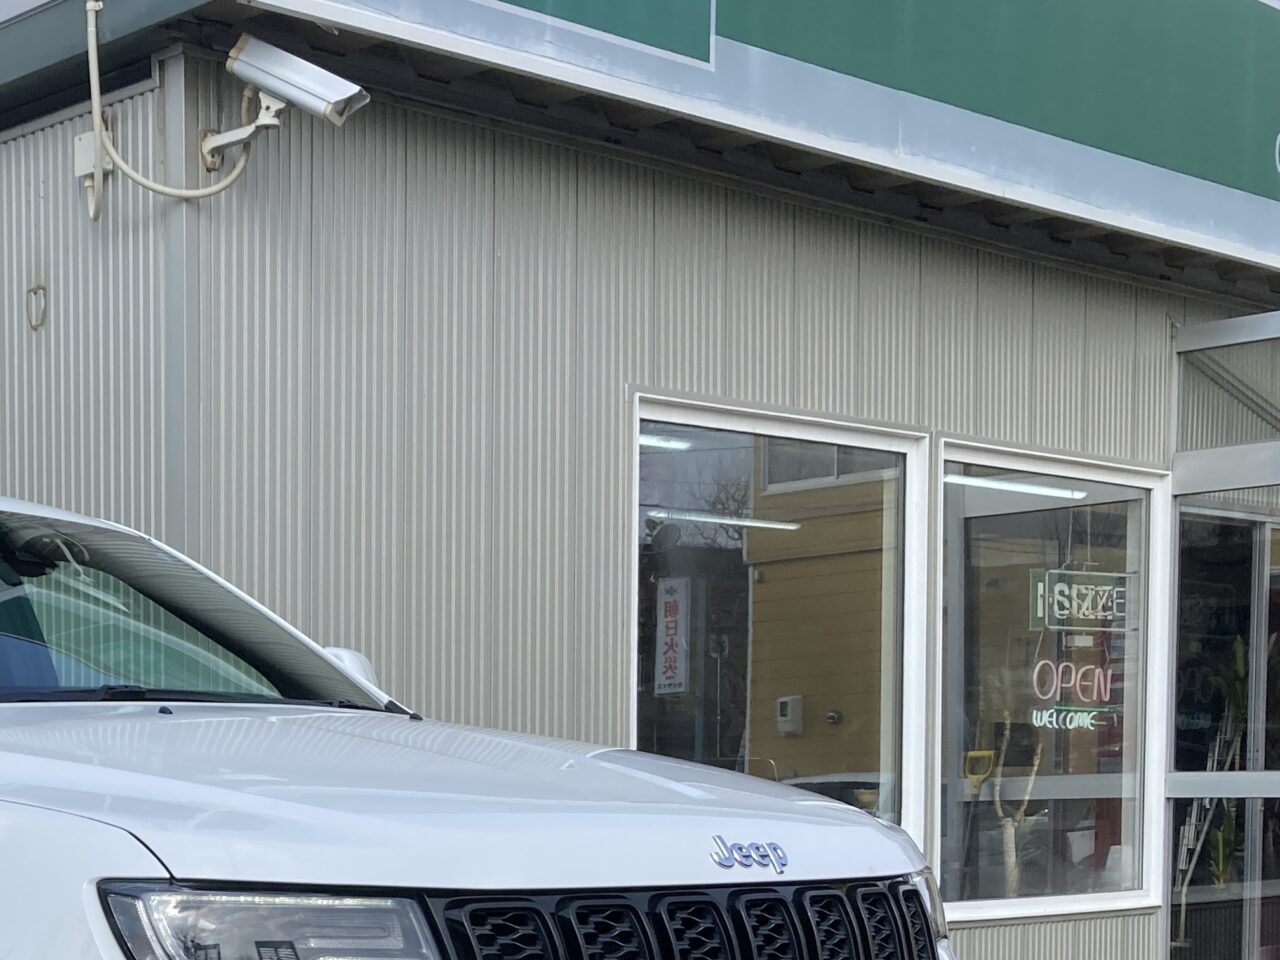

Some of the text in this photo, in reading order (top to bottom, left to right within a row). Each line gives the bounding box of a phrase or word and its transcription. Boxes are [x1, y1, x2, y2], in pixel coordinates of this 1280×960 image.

[1033, 659, 1113, 702] OPEN
[1032, 708, 1098, 731] WELCOME
[709, 834, 789, 875] Jeep
